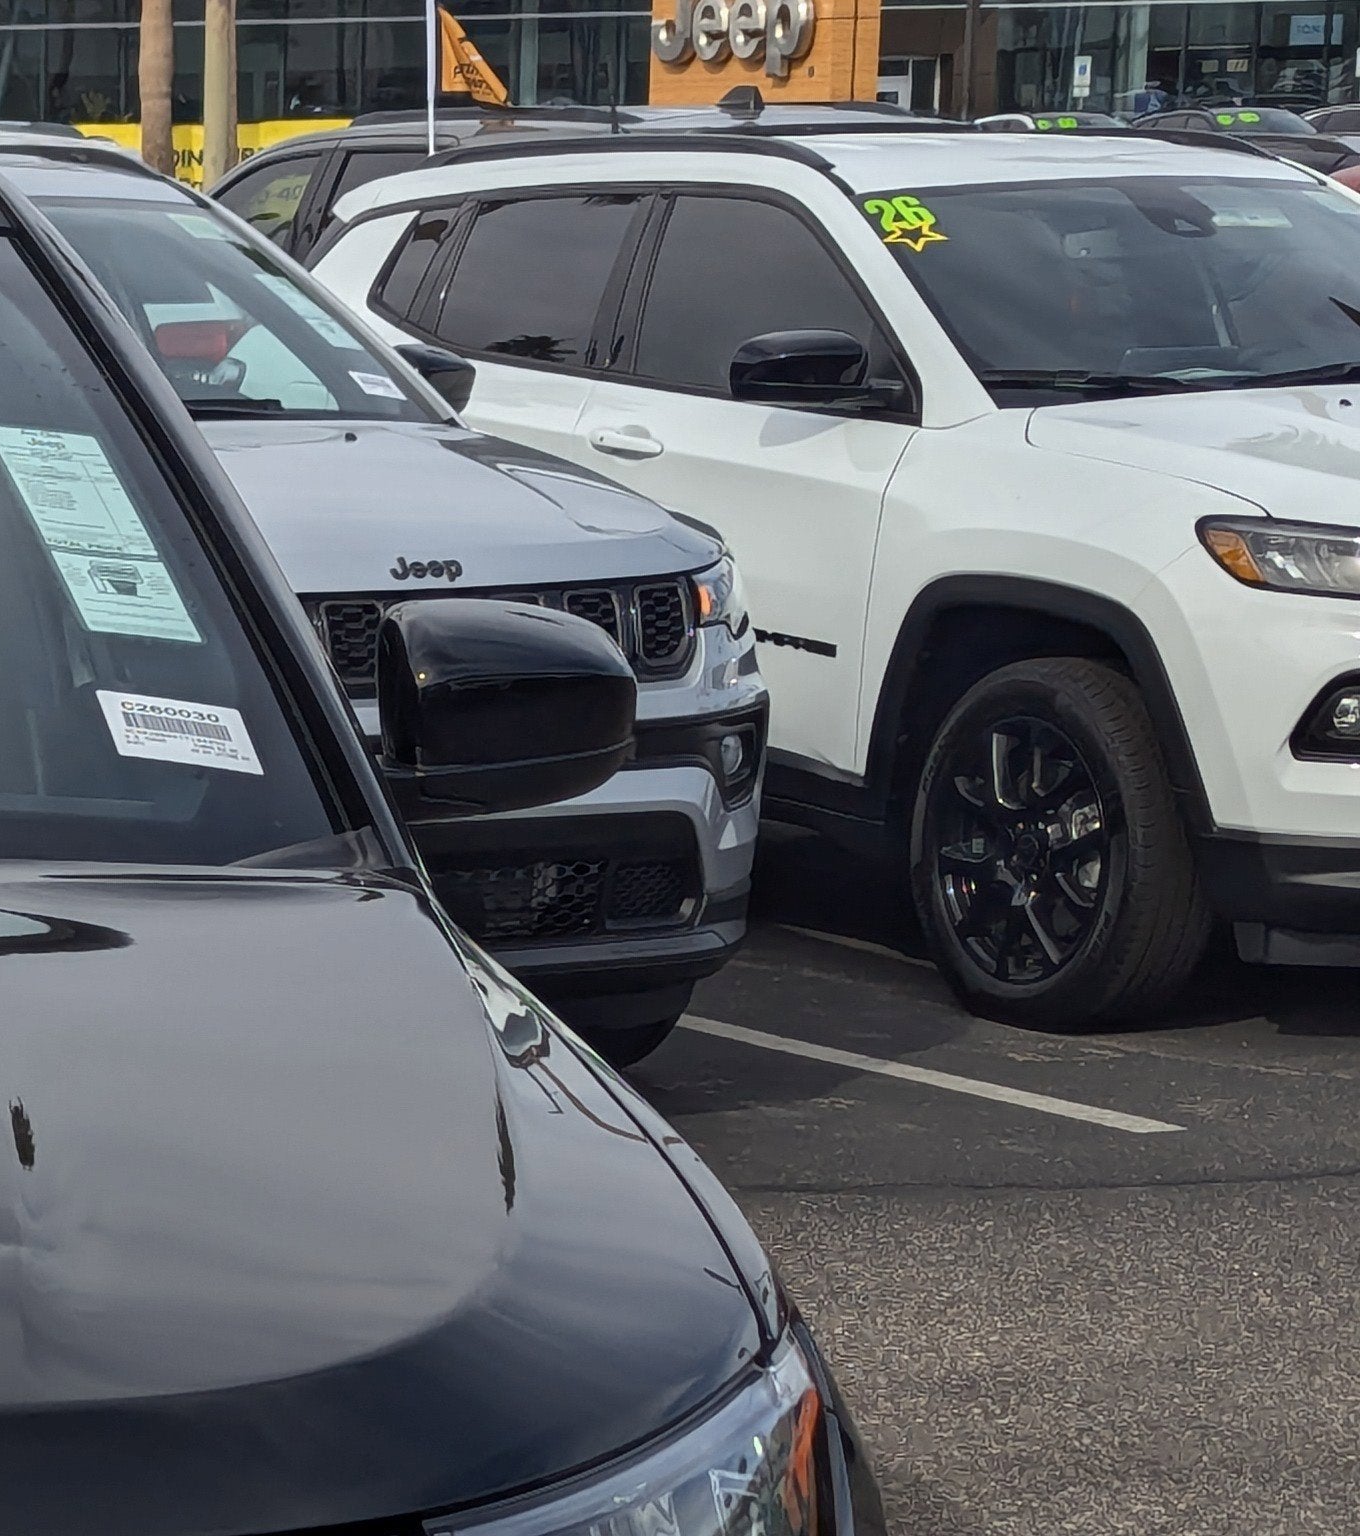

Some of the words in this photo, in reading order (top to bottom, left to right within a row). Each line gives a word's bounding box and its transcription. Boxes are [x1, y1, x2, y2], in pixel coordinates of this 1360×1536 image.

[651, 0, 814, 77] Jeep
[864, 196, 936, 232] 26
[389, 556, 463, 582] Jeep
